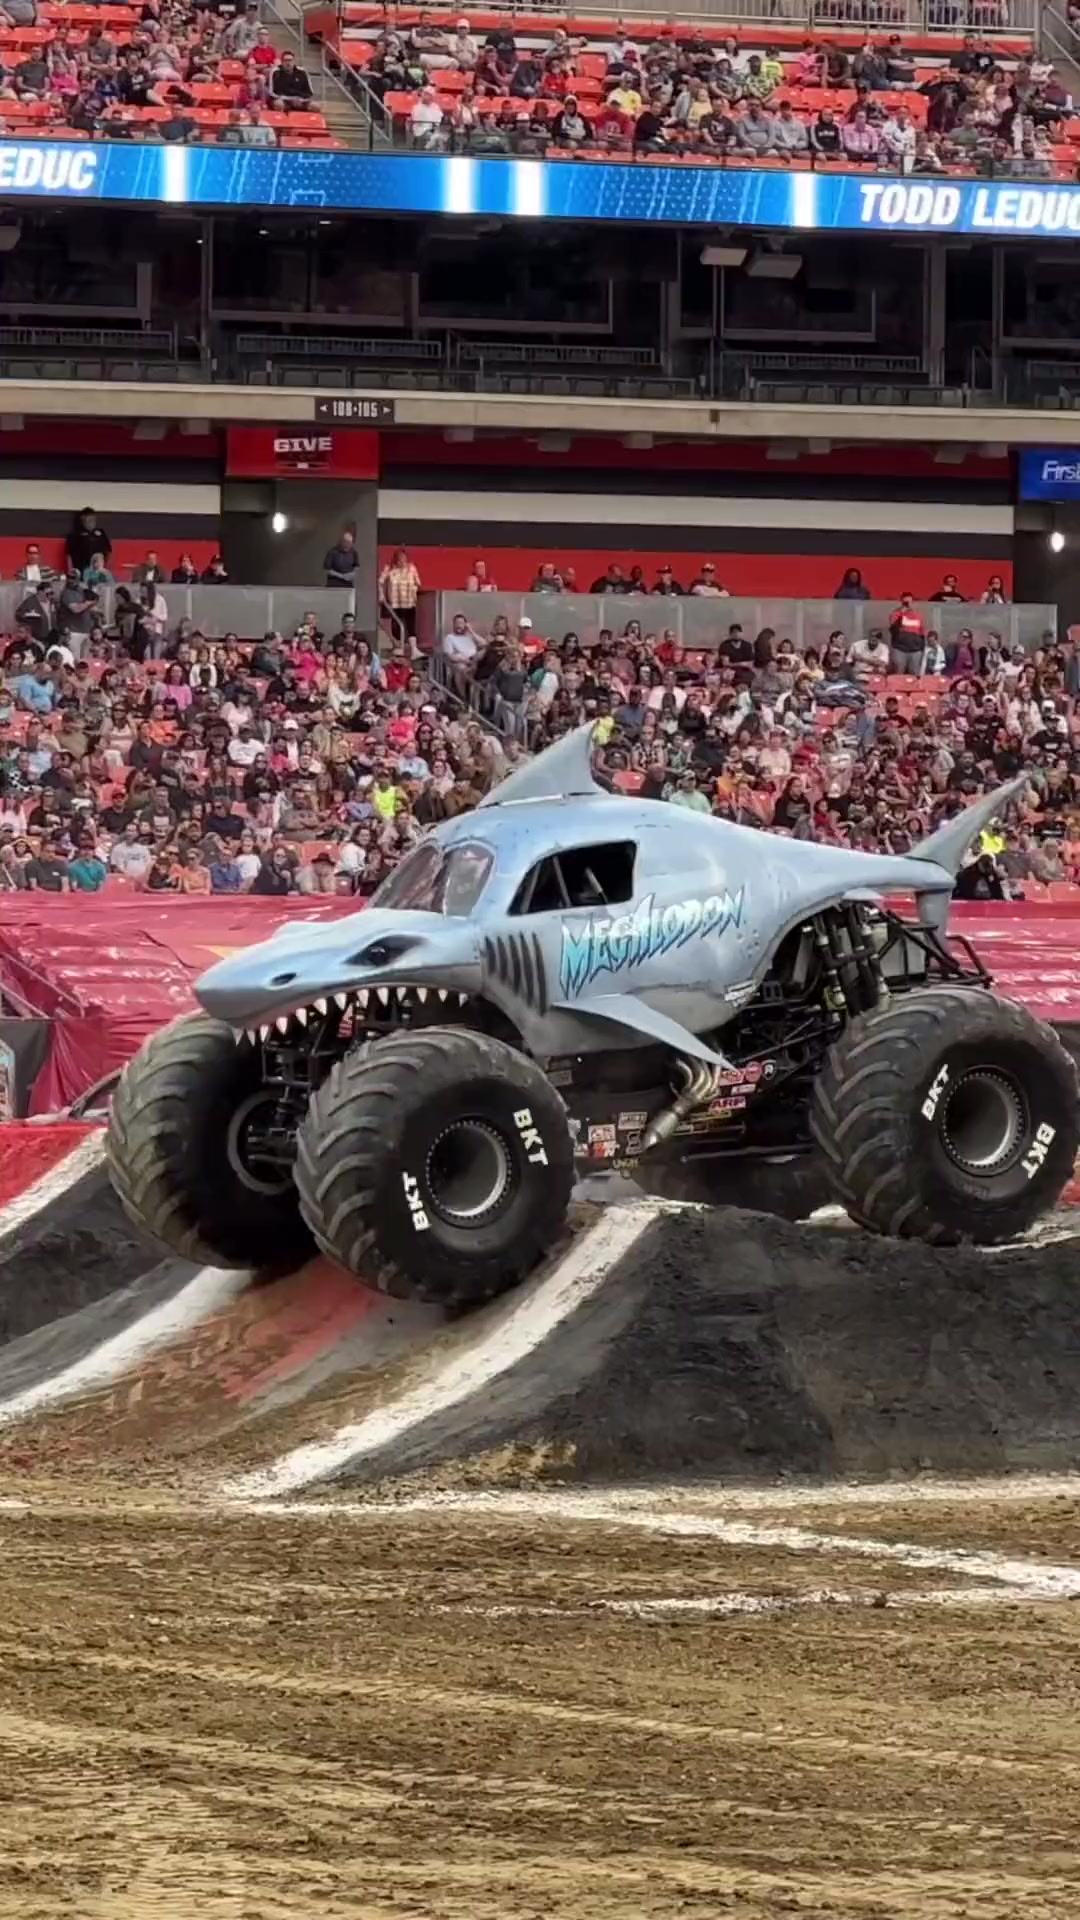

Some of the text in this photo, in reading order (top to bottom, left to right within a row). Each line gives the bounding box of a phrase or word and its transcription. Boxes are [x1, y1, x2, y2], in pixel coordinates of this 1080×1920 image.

[860, 184, 960, 225] TODD
[273, 437, 333, 452] GIVE
[560, 885, 745, 1001] MEGALODON
[921, 1063, 949, 1122] BKT
[512, 1108, 549, 1166] BKT
[1021, 1121, 1057, 1180] BKT
[402, 1171, 431, 1232] BKT
